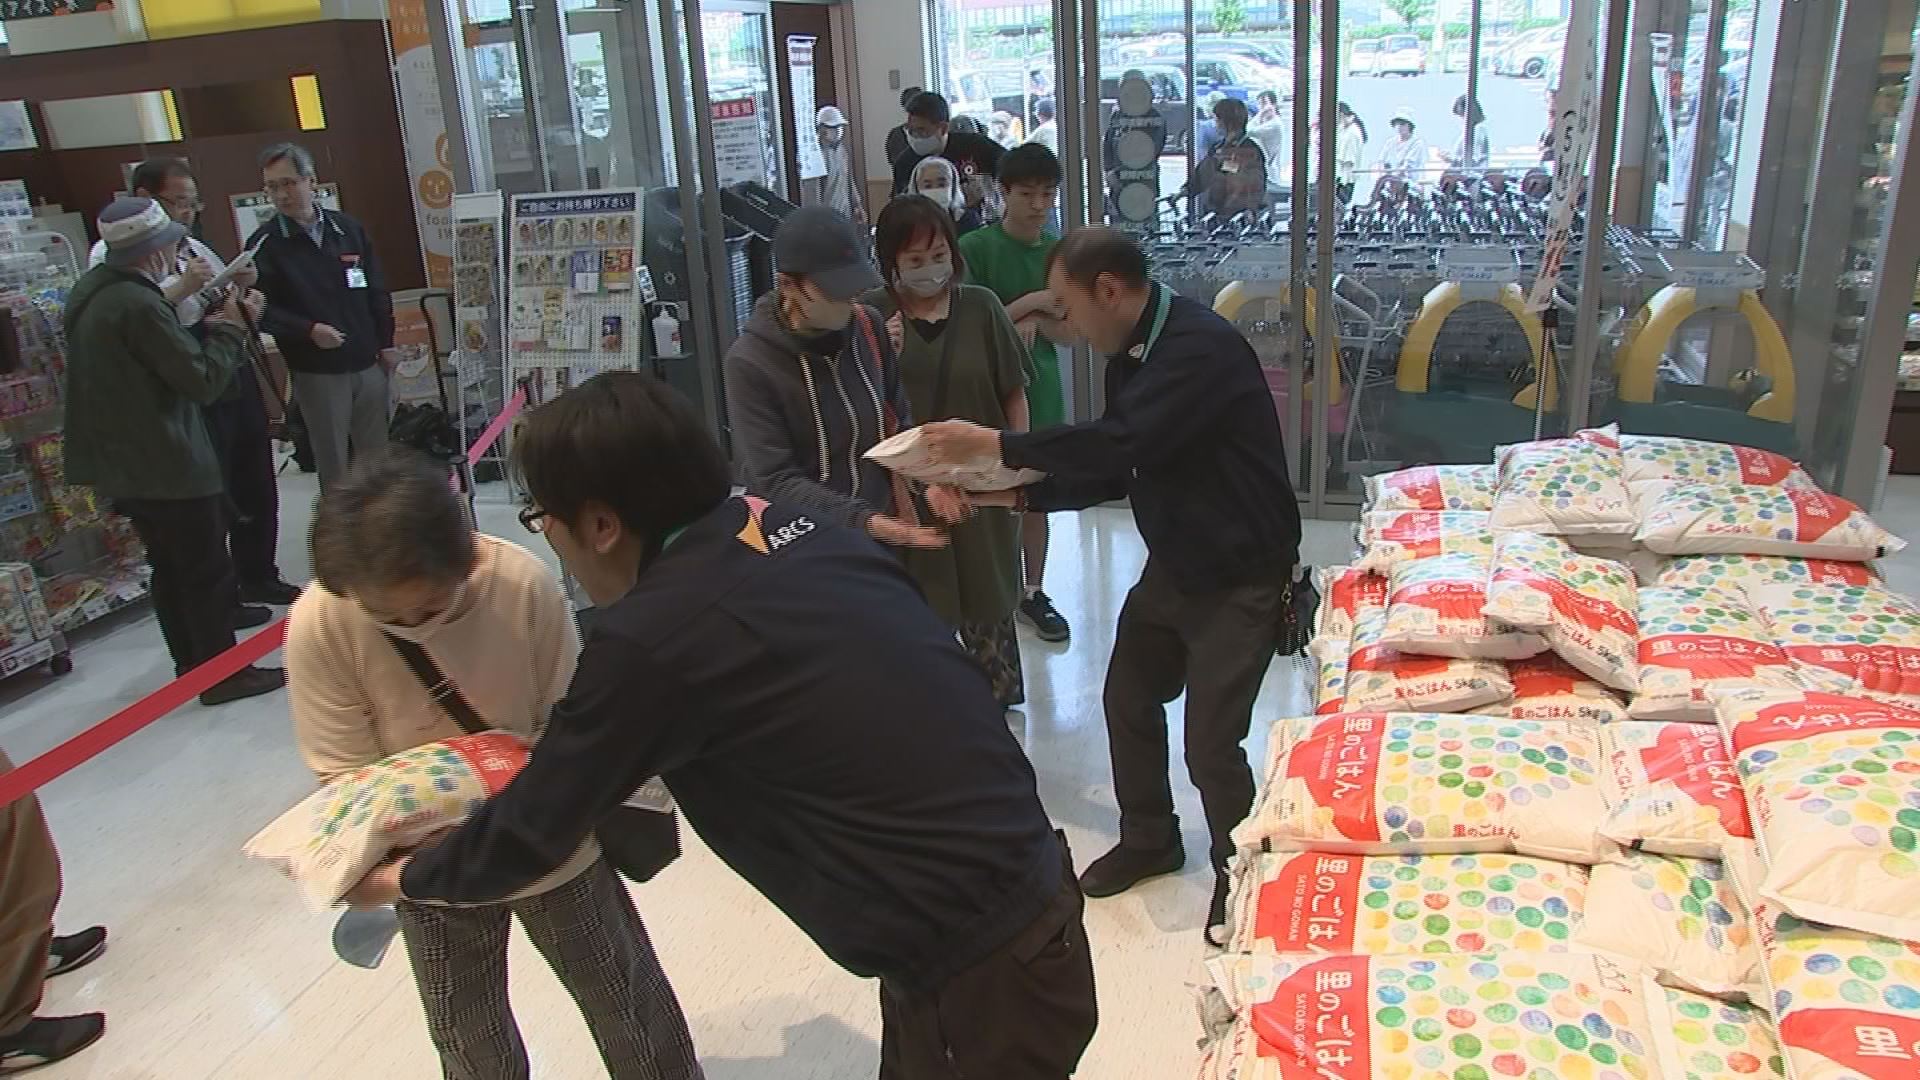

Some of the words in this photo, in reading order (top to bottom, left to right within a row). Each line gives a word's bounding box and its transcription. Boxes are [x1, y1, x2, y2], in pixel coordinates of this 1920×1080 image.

[768, 516, 815, 550] ARCS
[1652, 638, 1776, 659] 里のごはん
[1394, 680, 1452, 700] 里のごはん
[1512, 705, 1575, 720] 里のごはん
[1332, 717, 1373, 799] 里のごはん
[1453, 823, 1521, 840] 里のごはん
[1854, 1025, 1920, 1062] 里
